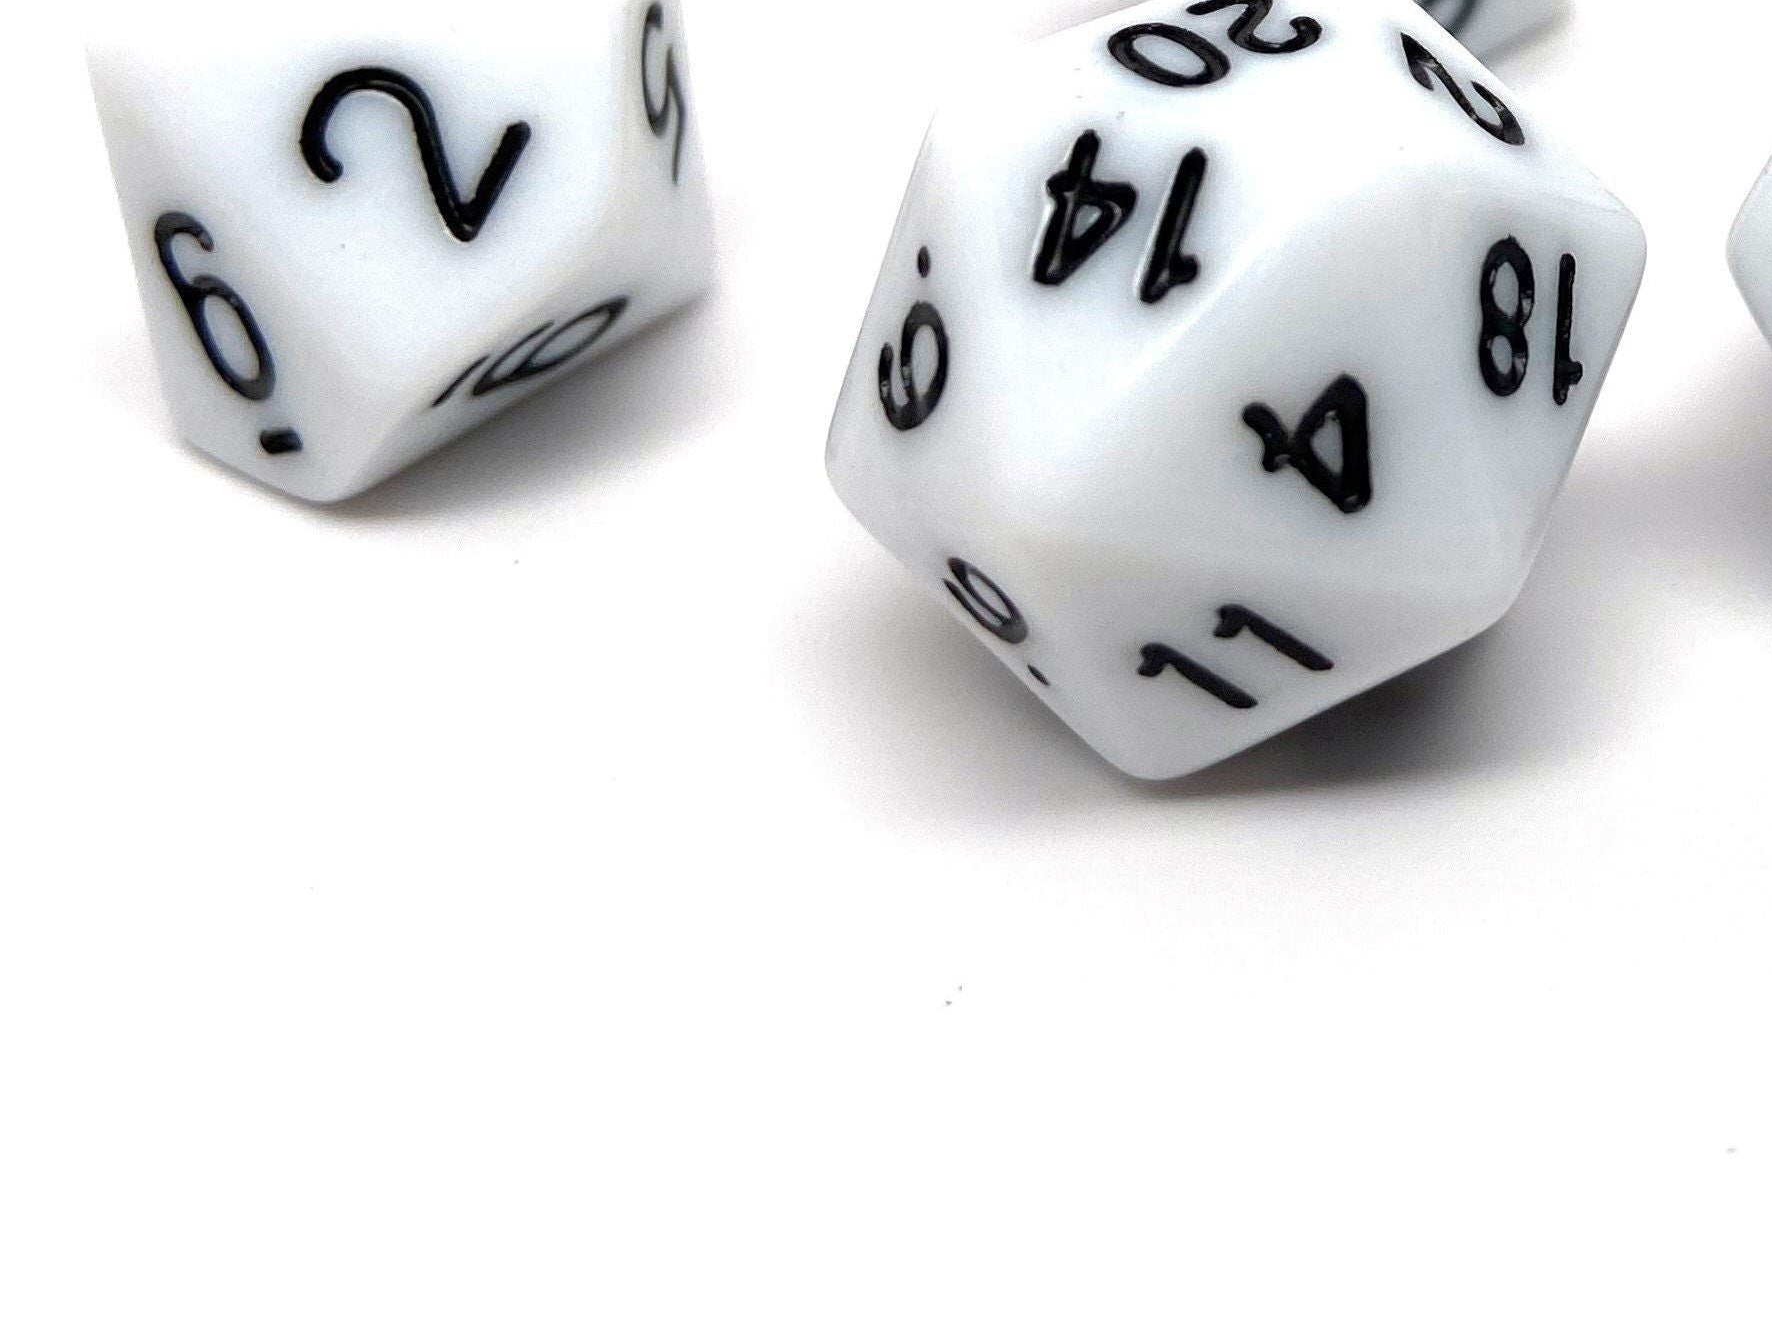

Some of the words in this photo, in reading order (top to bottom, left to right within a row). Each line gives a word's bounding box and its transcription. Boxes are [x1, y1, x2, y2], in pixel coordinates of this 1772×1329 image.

[298, 65, 532, 243] 2
[1400, 32, 1525, 146] 2
[1032, 129, 1209, 307] 14
[1475, 233, 1584, 408] 18
[1240, 372, 1377, 518] 4
[1136, 600, 1336, 712] 11
